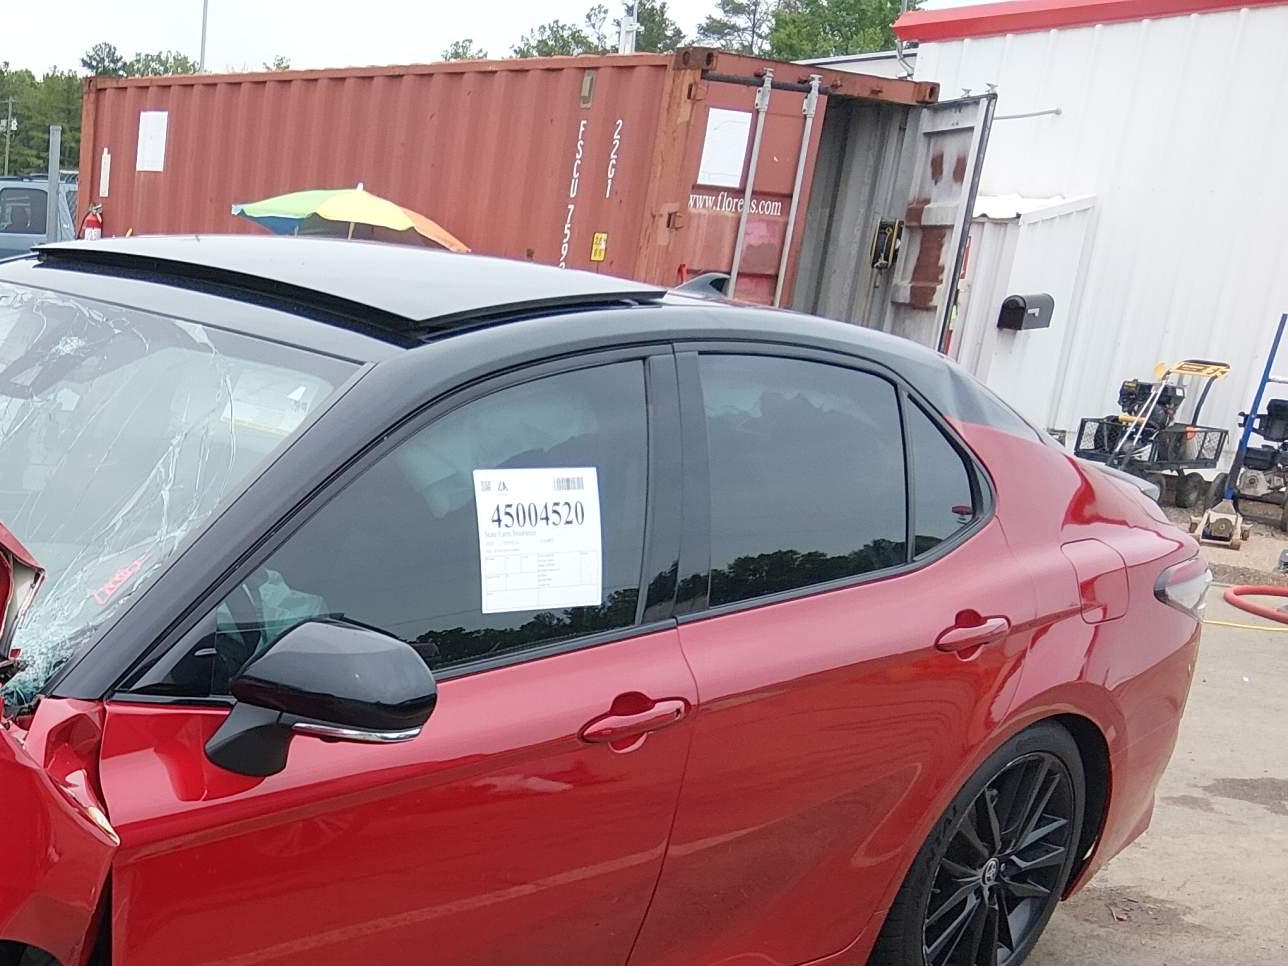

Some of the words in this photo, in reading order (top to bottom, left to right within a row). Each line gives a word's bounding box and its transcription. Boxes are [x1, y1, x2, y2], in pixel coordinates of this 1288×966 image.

[569, 119, 588, 198] FSCU
[605, 119, 623, 199] 22G1
[688, 191, 782, 216] www.flores.com
[491, 500, 584, 528] 45004520
